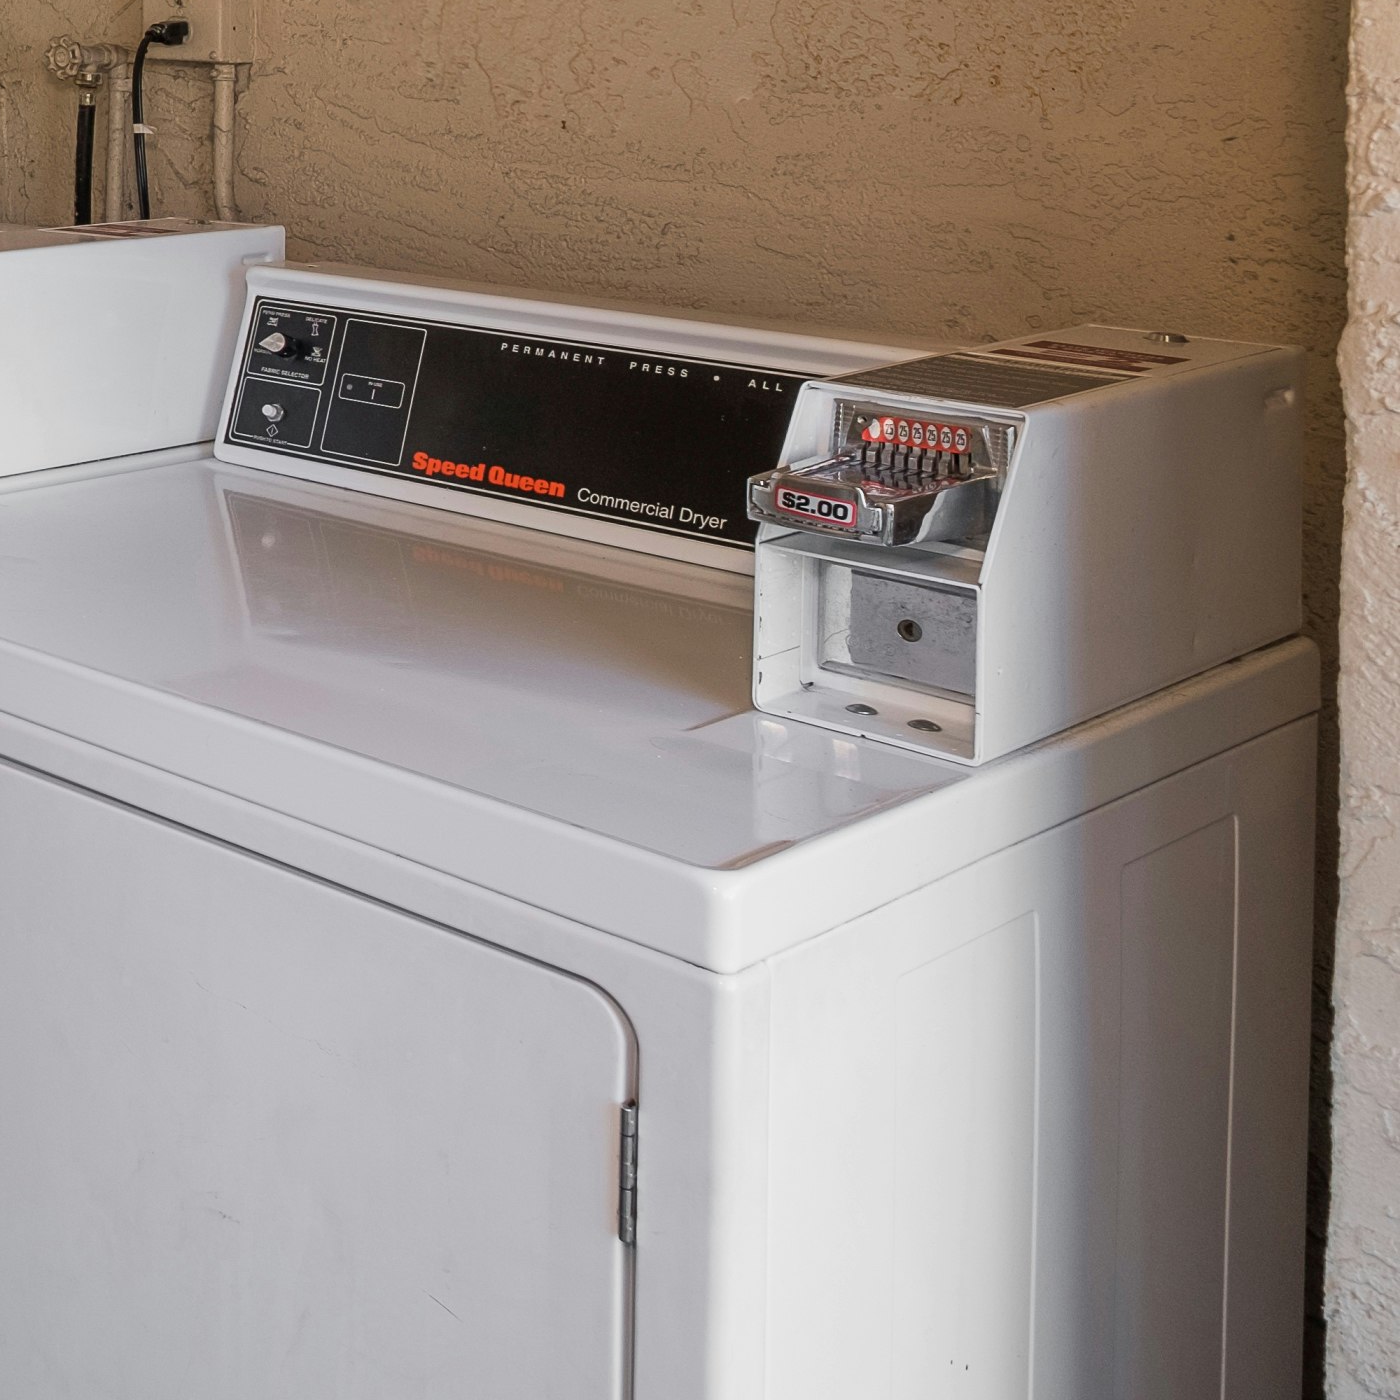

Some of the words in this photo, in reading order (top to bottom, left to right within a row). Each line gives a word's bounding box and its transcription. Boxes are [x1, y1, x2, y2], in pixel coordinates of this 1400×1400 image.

[260, 366, 281, 375] FABRIC
[281, 370, 310, 380] SELECTOR
[500, 342, 606, 366] PERMANENT
[629, 361, 689, 378] PRESS
[748, 378, 784, 392] ALL
[899, 424, 908, 437] 25
[913, 427, 922, 439] 25
[927, 429, 936, 442] 25
[941, 431, 951, 443] 25
[956, 433, 965, 446] 25
[412, 451, 486, 481] Speed
[488, 465, 566, 498] Queen
[577, 487, 674, 520] Commercial
[679, 507, 728, 530] Dryer
[781, 491, 849, 521] $2.00
